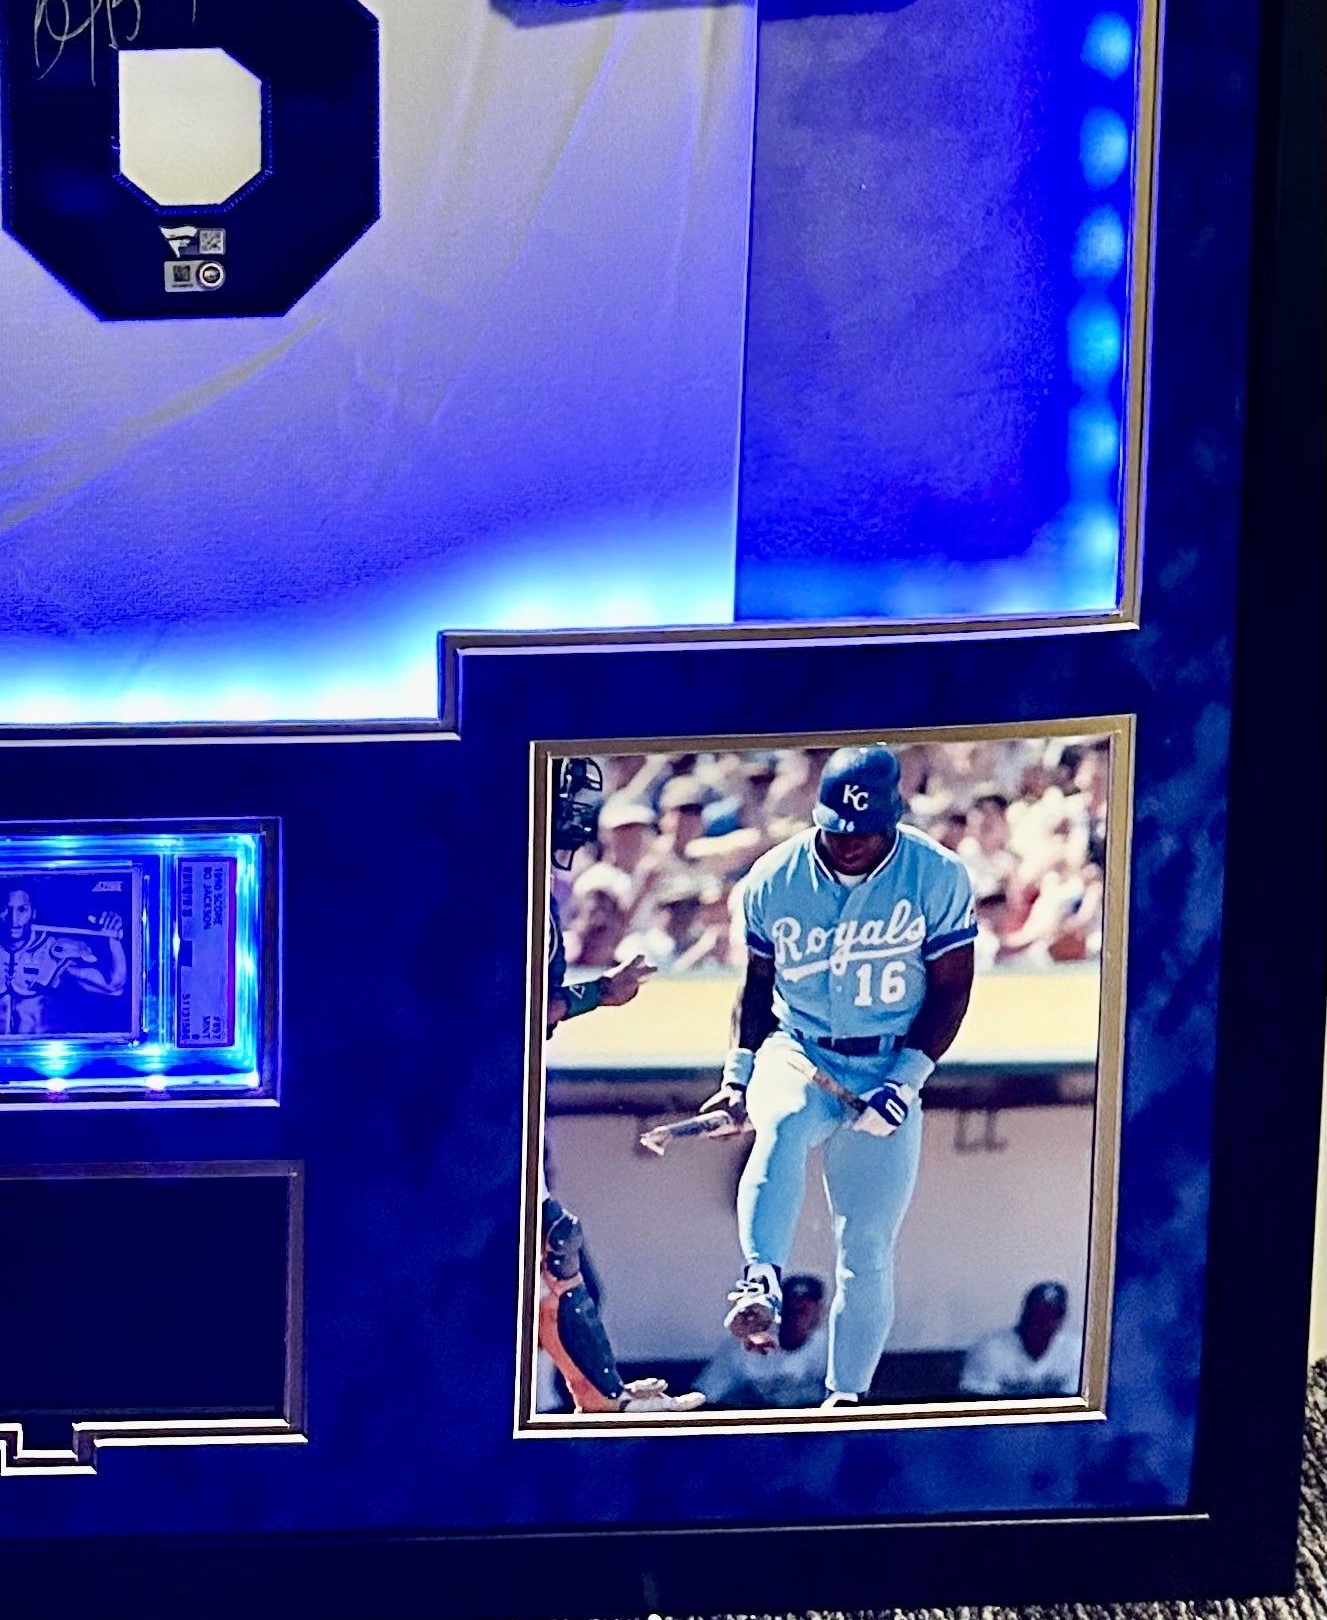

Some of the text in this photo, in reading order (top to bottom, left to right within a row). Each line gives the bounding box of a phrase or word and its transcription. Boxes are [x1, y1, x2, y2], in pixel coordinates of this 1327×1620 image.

[843, 784, 869, 811] KC
[773, 898, 927, 980] Royals
[854, 960, 907, 1007] 16
